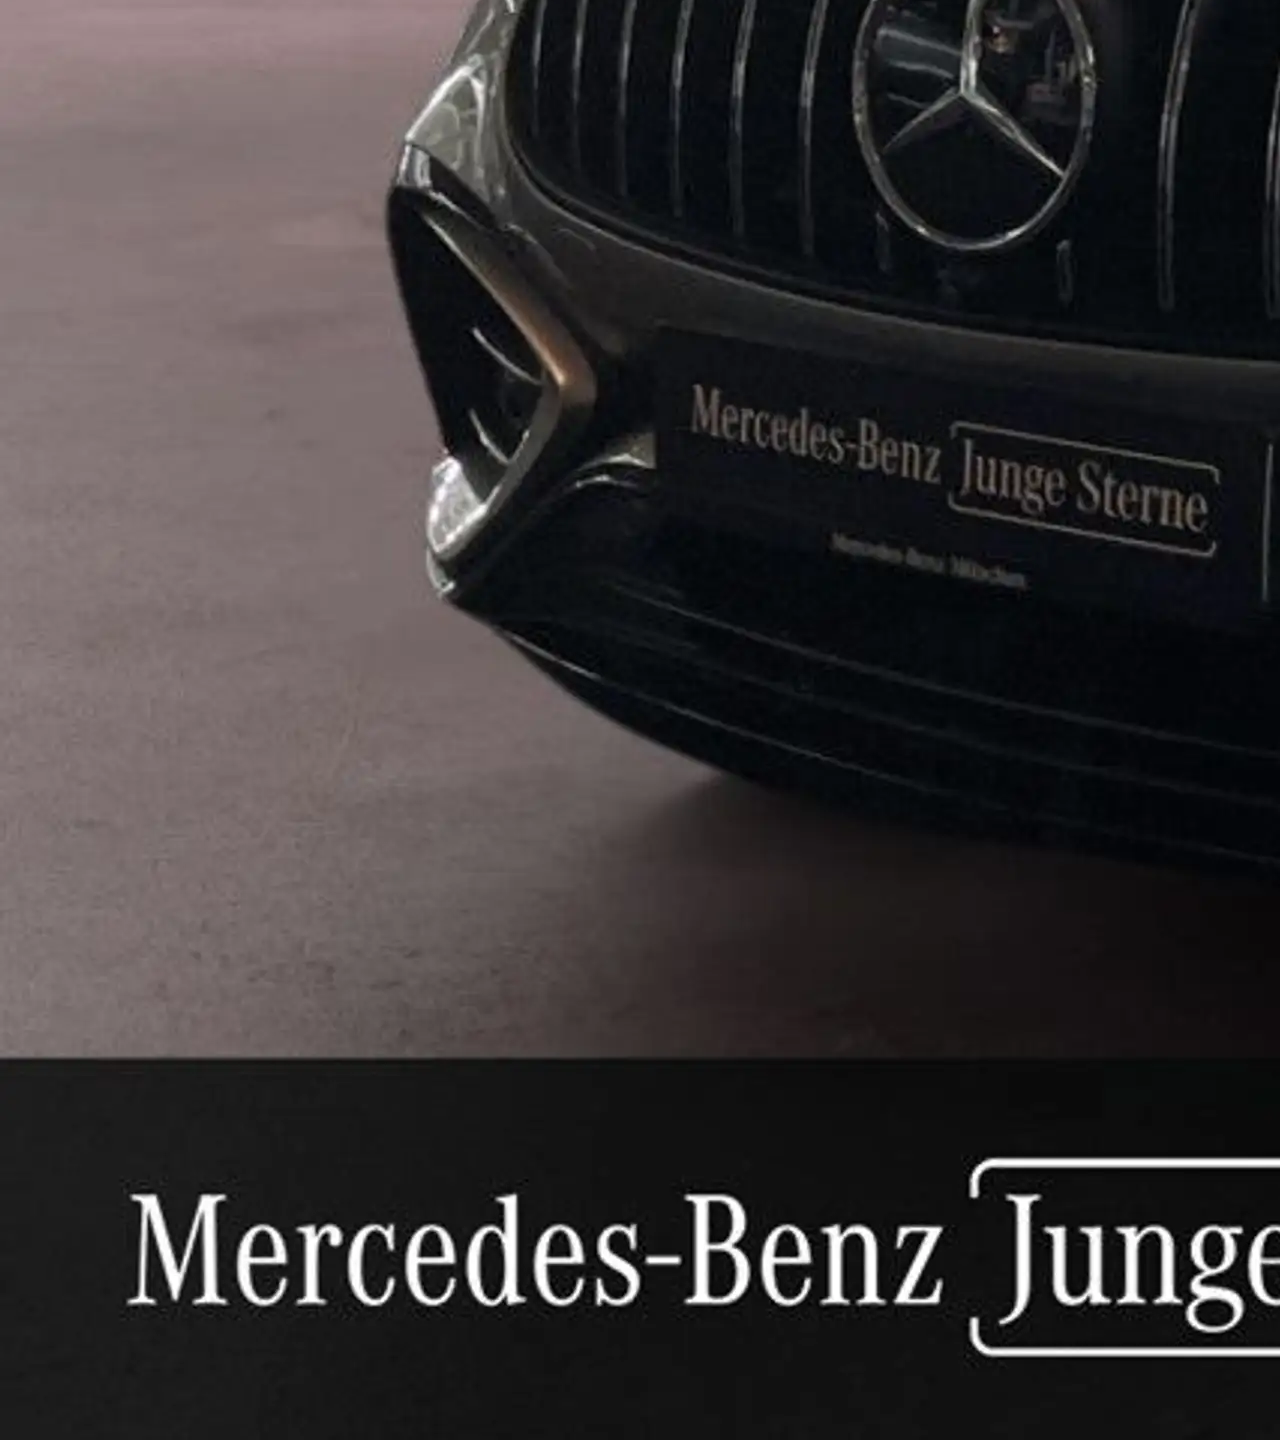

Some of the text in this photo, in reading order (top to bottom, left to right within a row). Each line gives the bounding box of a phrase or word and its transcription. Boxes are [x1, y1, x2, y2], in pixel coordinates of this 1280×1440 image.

[690, 383, 1211, 534] Mercedes-Benz Junge Sterne
